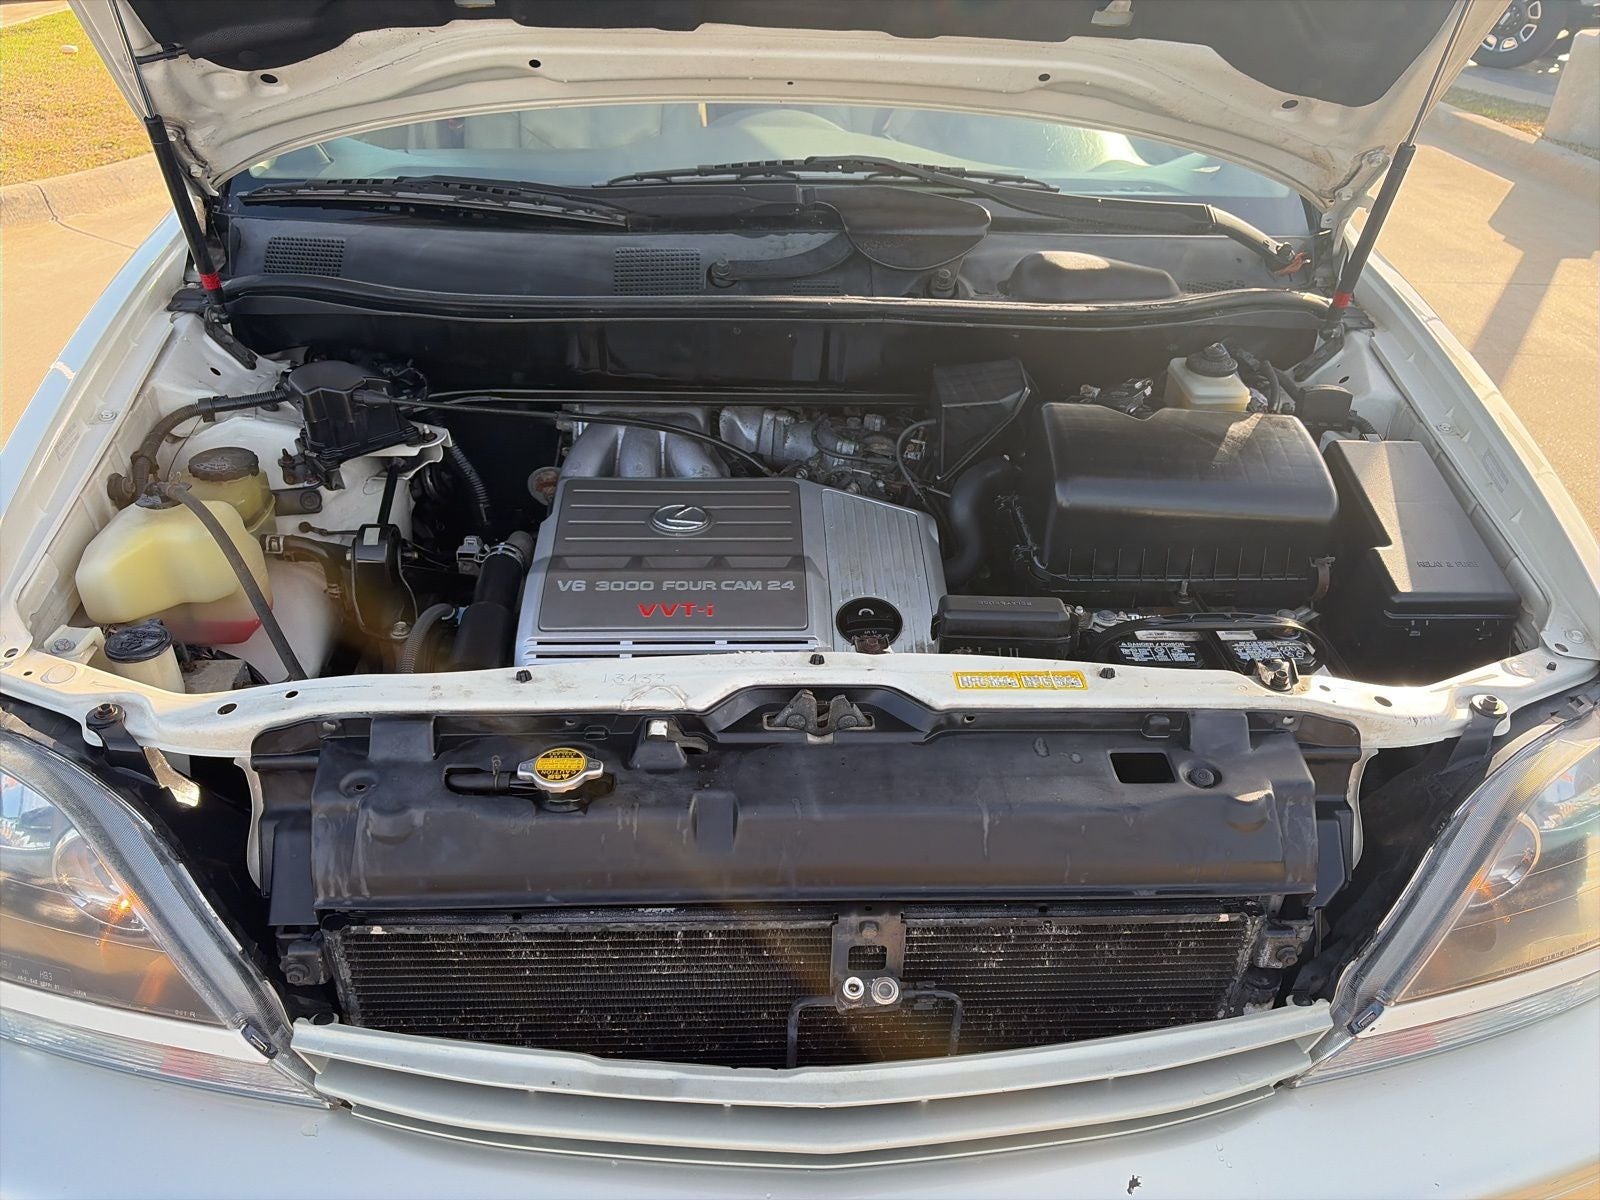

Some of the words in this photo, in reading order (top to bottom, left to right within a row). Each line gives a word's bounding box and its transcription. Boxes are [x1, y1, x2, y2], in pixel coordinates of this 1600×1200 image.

[557, 580, 586, 592] V6
[595, 581, 654, 591] 3000
[662, 580, 717, 591] FOUR
[720, 580, 762, 591] CAM
[767, 580, 795, 591] 24
[637, 603, 715, 618] VVT-i
